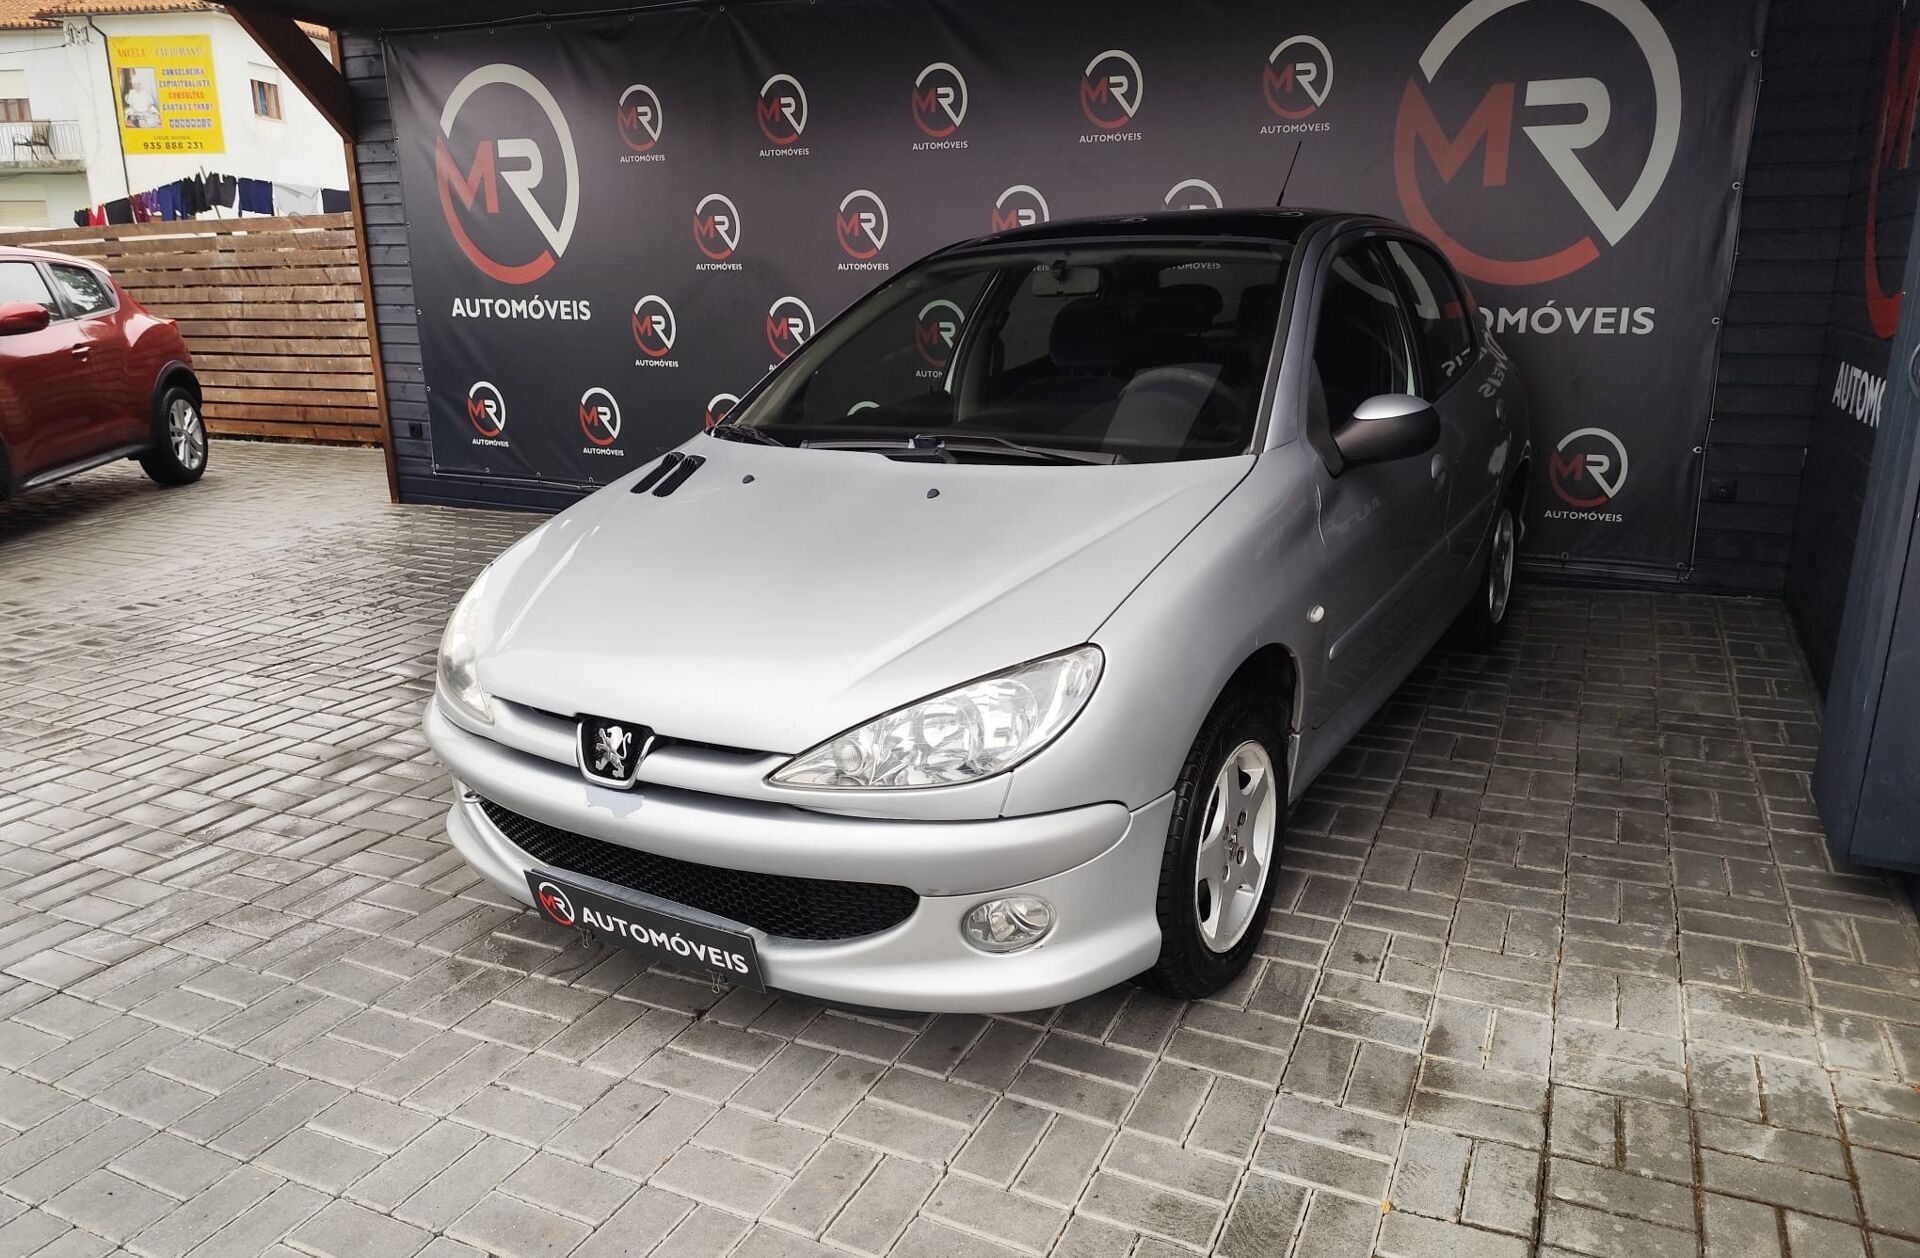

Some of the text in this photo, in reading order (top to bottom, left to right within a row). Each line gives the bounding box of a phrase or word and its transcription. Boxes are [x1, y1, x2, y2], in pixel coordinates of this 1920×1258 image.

[1260, 121, 1331, 135] AUTOMÓVEIS
[1079, 131, 1142, 143] AUTOMÓVEIS
[143, 141, 204, 150] 935 888 231
[912, 139, 969, 151] AUTOMÓVEIS
[759, 146, 810, 157] AUTOMÓVEIS
[620, 152, 666, 163] AUTOMÓVEIS
[695, 261, 743, 271] AUTOMÓVEIS
[837, 261, 890, 271] AUTOMÓVEIS
[451, 295, 592, 321] AUTOMÓVEIS
[635, 359, 679, 368] AUTOMÓVEIS
[472, 438, 510, 448] AUTOMÓVEIS
[583, 447, 625, 457] AUTOMÓVEIS
[1544, 510, 1623, 523] AUTOMÓVEIS
[583, 906, 750, 974] AUTOMÓVEIS
